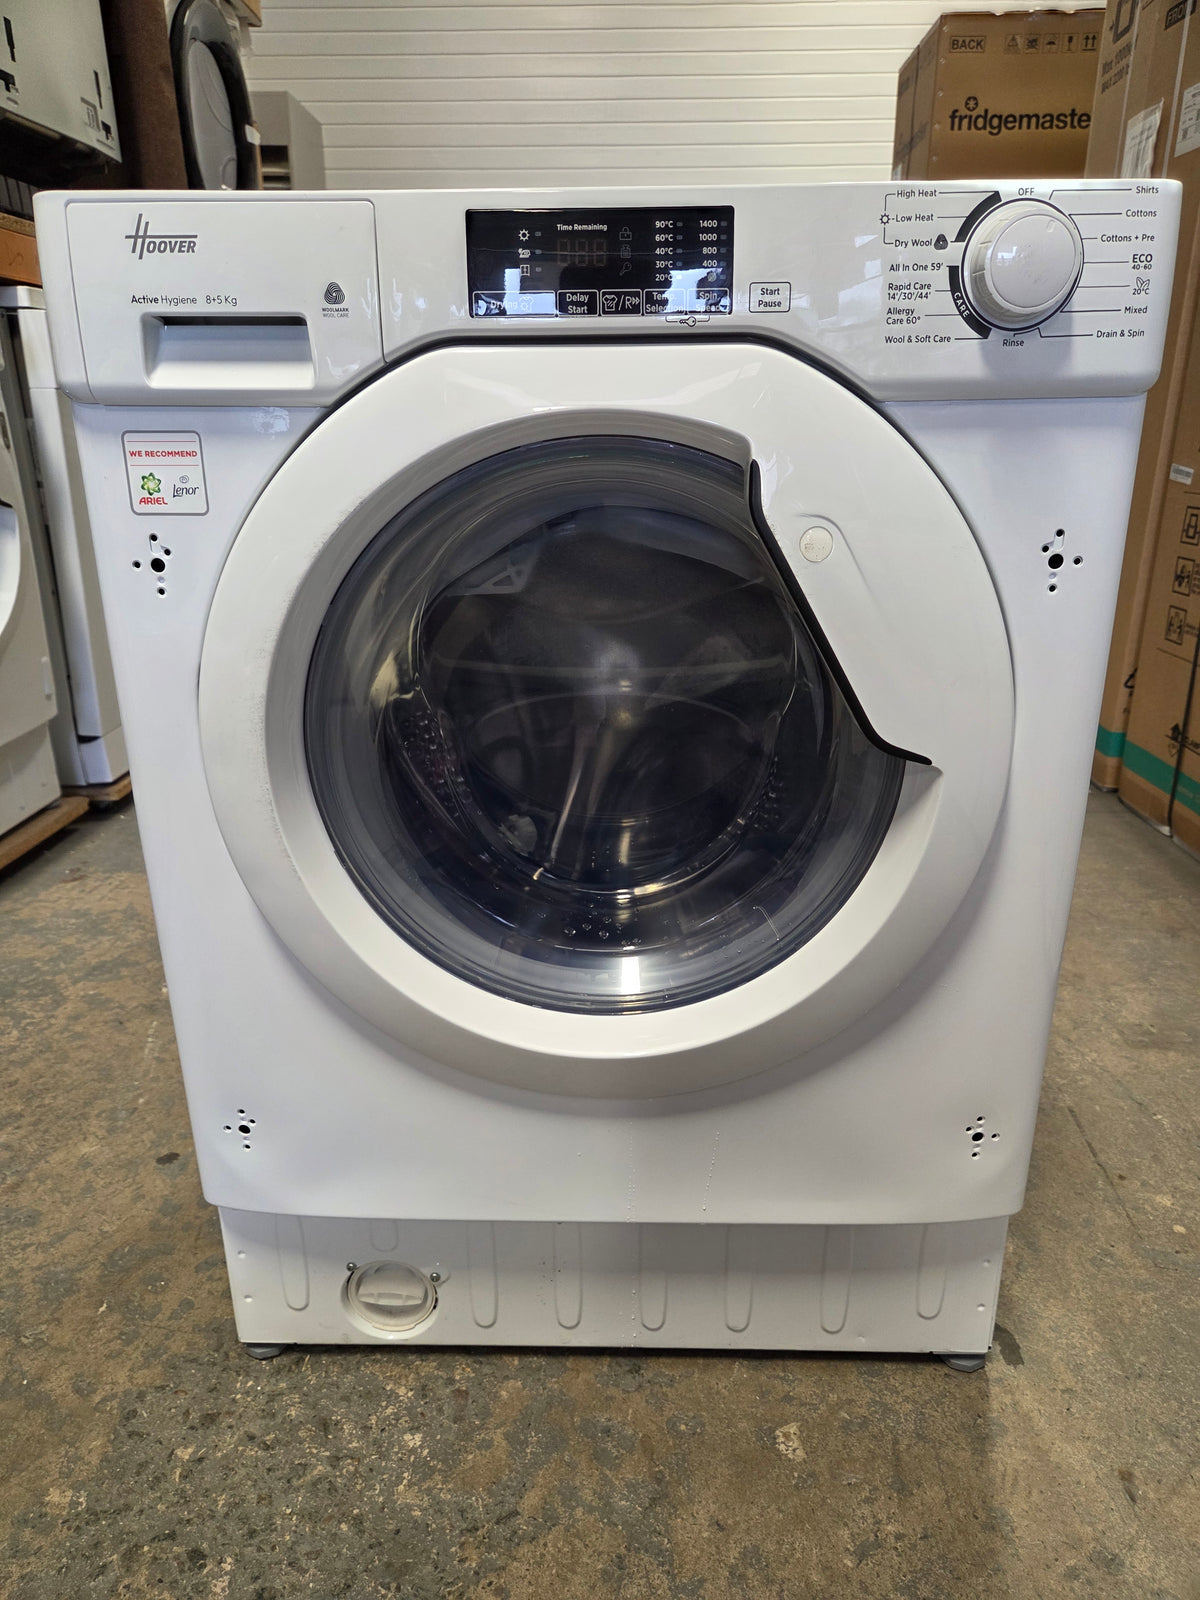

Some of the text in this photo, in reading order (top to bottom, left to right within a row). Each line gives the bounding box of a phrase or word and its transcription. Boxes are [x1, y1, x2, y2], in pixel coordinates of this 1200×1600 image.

[951, 38, 984, 51] BACK
[949, 96, 1091, 136] fridgemaste
[896, 188, 937, 198] High Heat
[1018, 187, 1035, 196] OFF
[1135, 185, 1159, 195] Shirts
[895, 213, 934, 222] Low Heat
[1125, 208, 1157, 218] Cottons
[556, 223, 608, 232] Time Remaining
[655, 220, 674, 228] 90°C
[699, 220, 718, 228] 1400
[699, 233, 718, 241] 1000
[1100, 233, 1132, 243] Cottons
[1141, 233, 1155, 243] Pre
[894, 238, 933, 249] Dry Wool
[655, 247, 673, 255] 40°C
[702, 247, 717, 255] 800
[702, 260, 718, 268] 400
[1132, 254, 1153, 264] ECO
[889, 263, 900, 272] All
[902, 263, 909, 272] In
[910, 263, 929, 272] One
[760, 287, 780, 296] Start
[888, 281, 932, 293] Rapid Care
[1132, 287, 1150, 296] 20°C
[131, 295, 237, 306] Active Hygiene 8+5 Kg
[566, 293, 589, 303] Delay
[699, 291, 718, 301] Spin
[758, 299, 782, 308] Pause
[953, 291, 970, 319] CARE
[567, 305, 588, 314] Start
[886, 307, 915, 318] Allergy
[1124, 305, 1148, 315] Mixed
[886, 316, 921, 325] Care 60°
[884, 334, 951, 344] Wool & Soft Care
[1096, 328, 1145, 340] Drain & Spin
[1002, 338, 1025, 348] Rinse
[128, 450, 198, 458] WE RECOMMEND
[172, 483, 200, 498] Lenor
[139, 496, 168, 505] ARIEL
